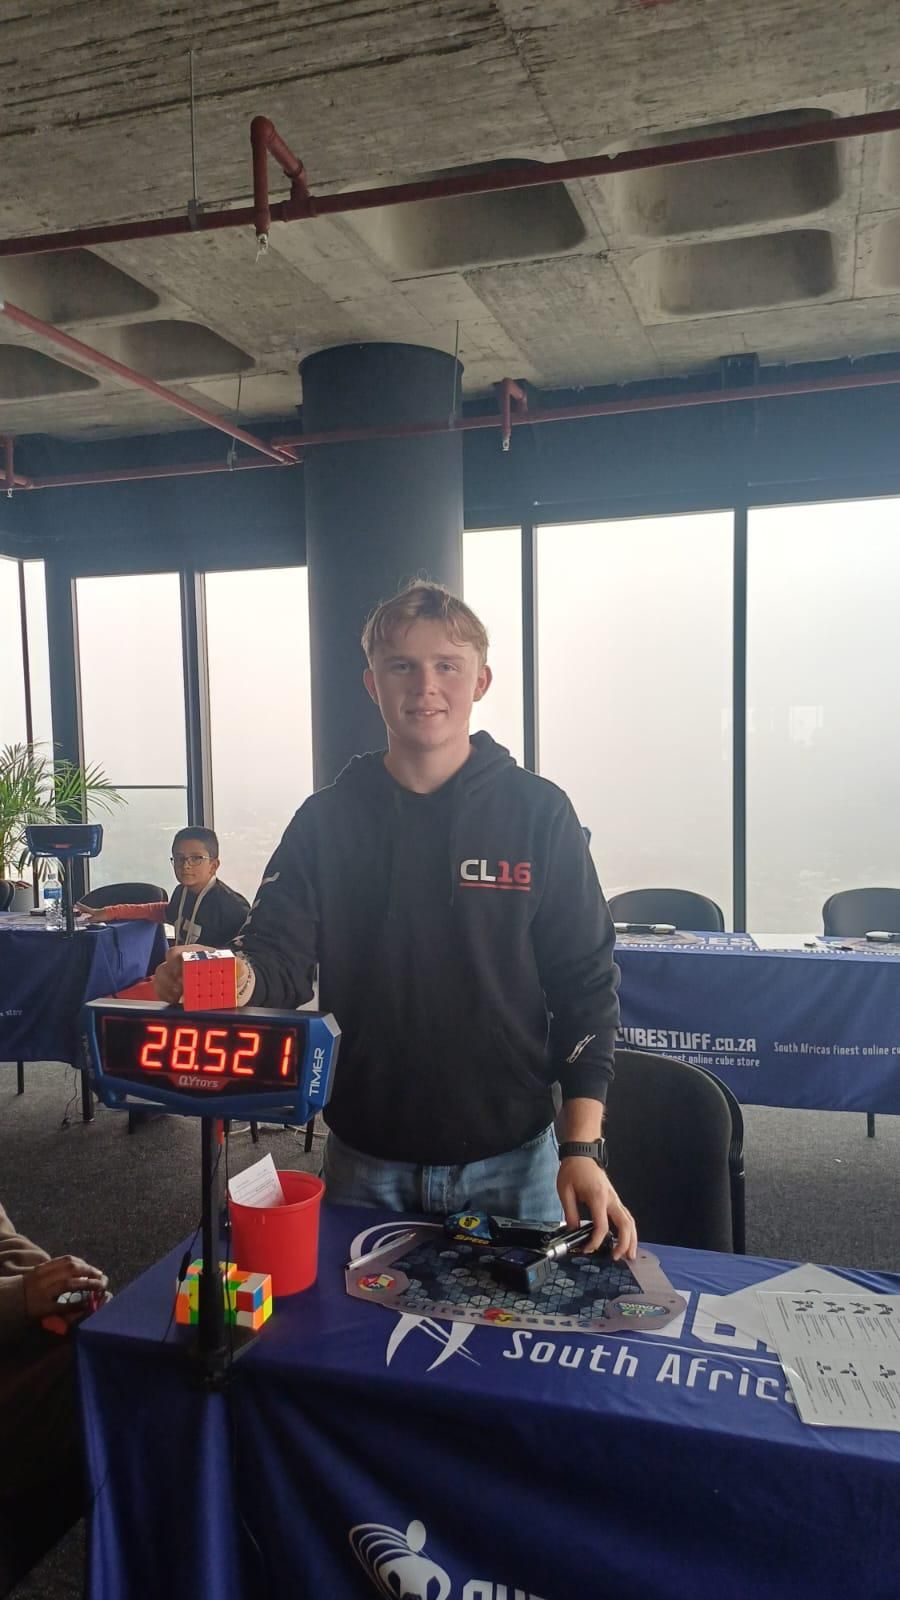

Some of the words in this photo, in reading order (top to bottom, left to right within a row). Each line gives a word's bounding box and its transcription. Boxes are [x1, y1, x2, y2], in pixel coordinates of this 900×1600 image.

[460, 859, 531, 884] CL16
[141, 1026, 292, 1077] 28.521
[688, 1053, 713, 1065] online
[715, 1056, 734, 1066] cube
[737, 1056, 760, 1067] store
[774, 1041, 799, 1053] South
[800, 1043, 831, 1055] Africas
[833, 1044, 860, 1055] finest
[862, 1044, 889, 1056] online
[308, 1047, 325, 1097] TIMER
[502, 1330, 640, 1378] South
